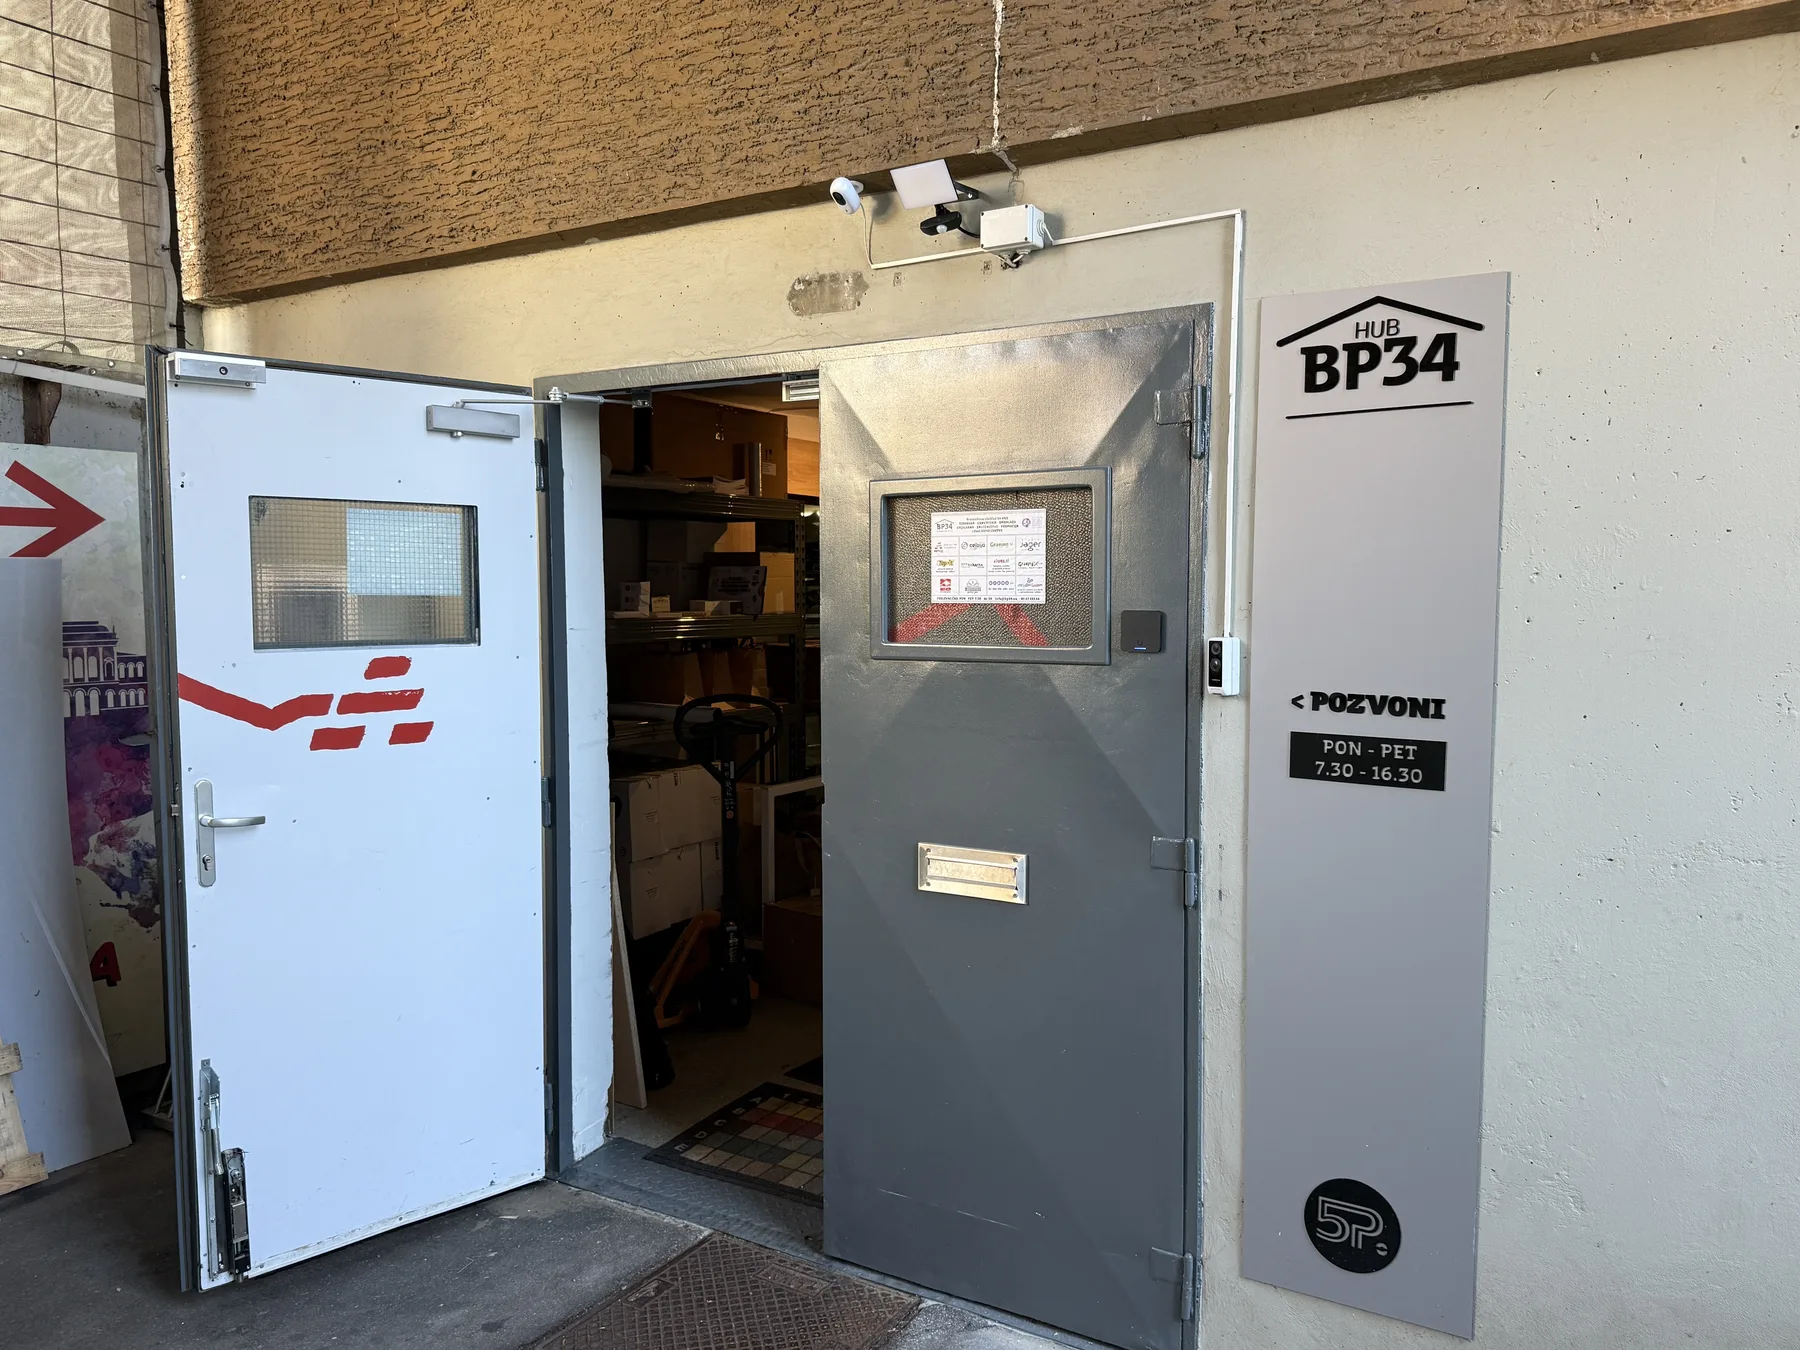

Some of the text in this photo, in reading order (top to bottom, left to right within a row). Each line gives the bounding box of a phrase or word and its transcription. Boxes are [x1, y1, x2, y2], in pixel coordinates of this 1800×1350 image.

[1355, 318, 1400, 339] HUB
[1301, 332, 1459, 393] BP34
[1310, 691, 1446, 720] POZVONI
[1323, 740, 1362, 756] PON
[1380, 743, 1418, 760] PET
[1315, 761, 1354, 778] 7.30
[1371, 765, 1423, 784] 16.30
[693, 1130, 708, 1139] D
[674, 1143, 689, 1152] E
